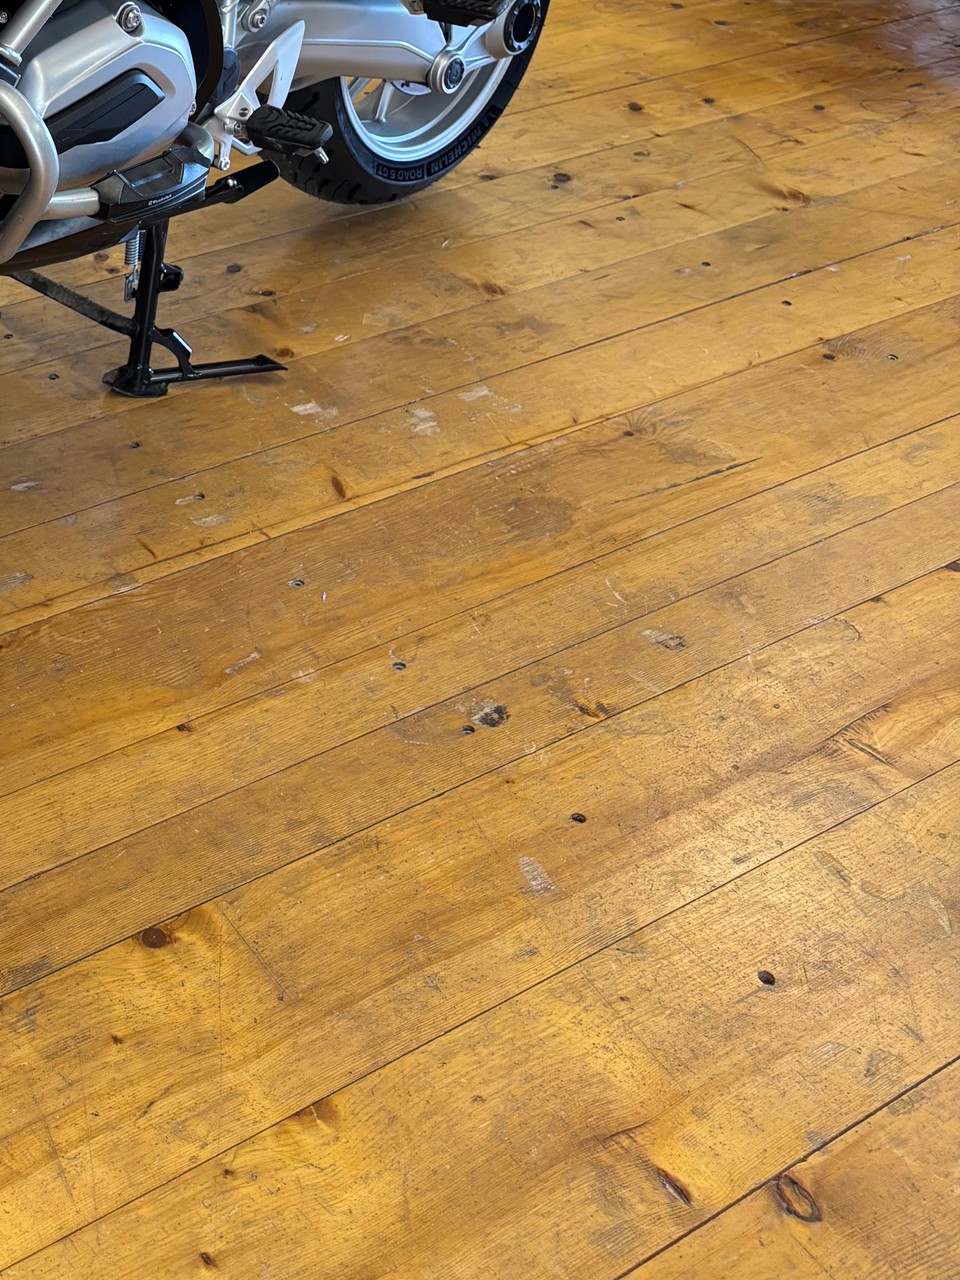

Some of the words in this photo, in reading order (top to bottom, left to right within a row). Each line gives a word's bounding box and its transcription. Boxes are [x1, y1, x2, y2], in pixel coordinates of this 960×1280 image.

[430, 124, 483, 170] MICHELIN
[378, 165, 388, 177] GT
[397, 166, 423, 180] ROAD
